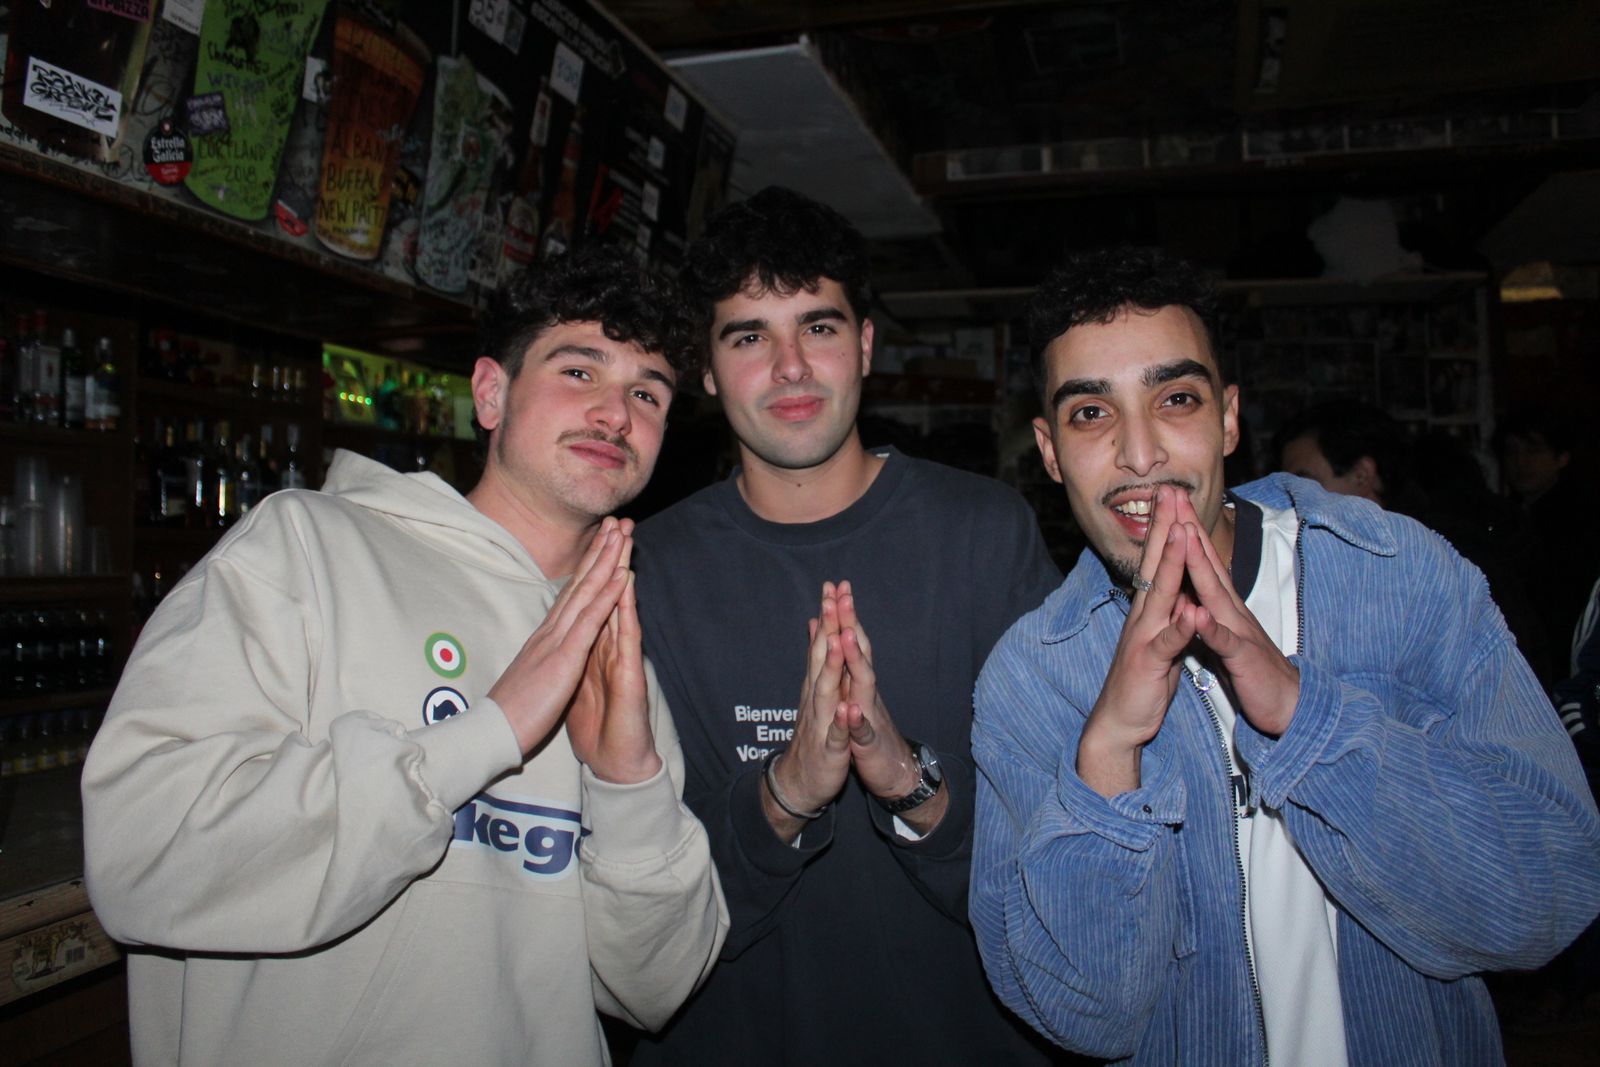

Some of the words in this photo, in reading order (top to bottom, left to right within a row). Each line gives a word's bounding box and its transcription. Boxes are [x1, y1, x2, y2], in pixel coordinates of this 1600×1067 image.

[150, 136, 186, 150] Estrella
[151, 148, 185, 163] Galicia
[319, 199, 349, 224] NEW
[454, 803, 580, 875] keg
